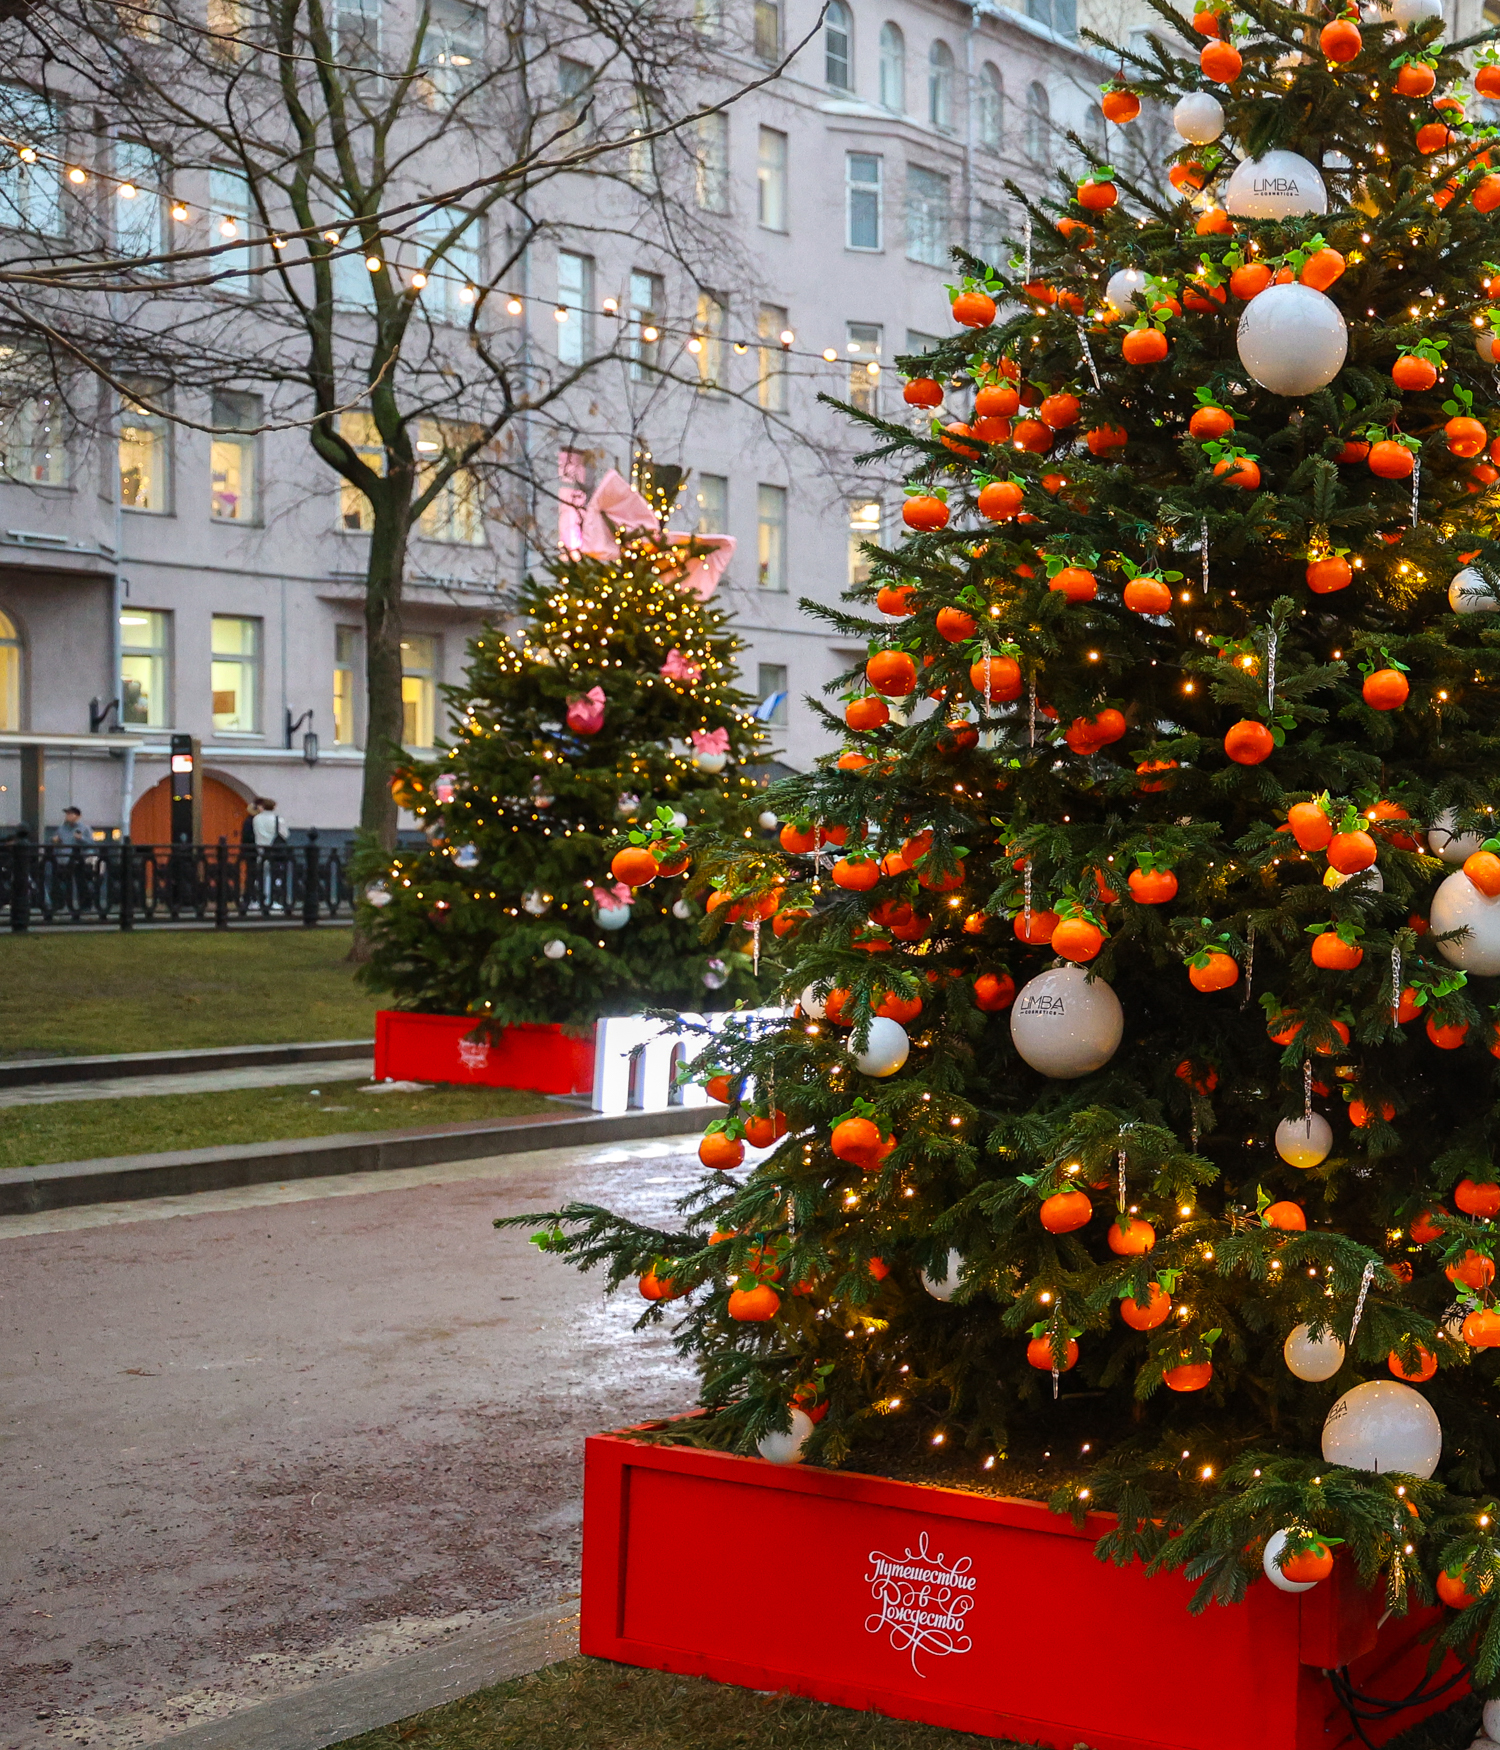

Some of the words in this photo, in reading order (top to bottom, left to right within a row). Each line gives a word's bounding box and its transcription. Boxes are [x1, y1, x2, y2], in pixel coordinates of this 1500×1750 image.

[1253, 177, 1299, 193] LIMBA
[1020, 995, 1065, 1012] LIMBA
[865, 1550, 977, 1591] Путешествие
[867, 1579, 974, 1634] Рождество
